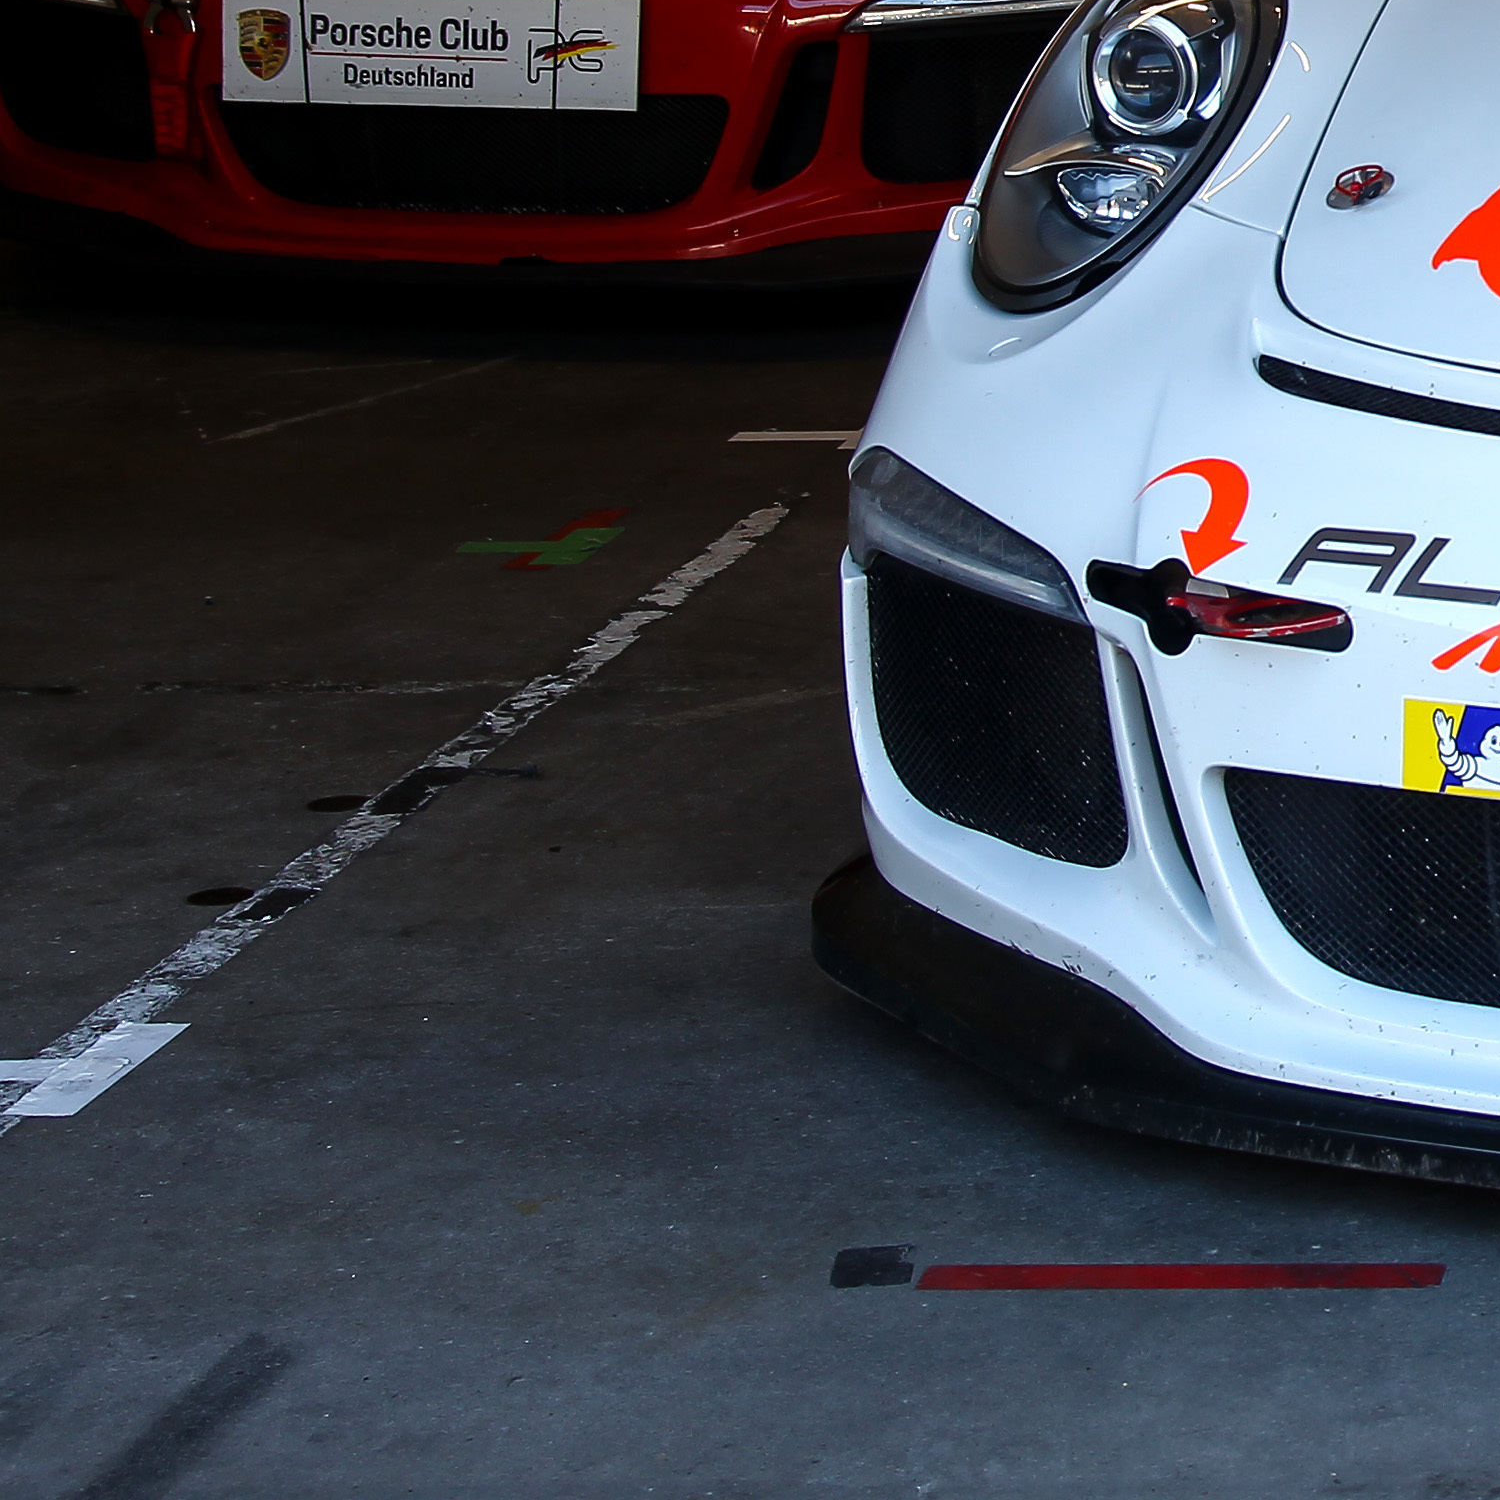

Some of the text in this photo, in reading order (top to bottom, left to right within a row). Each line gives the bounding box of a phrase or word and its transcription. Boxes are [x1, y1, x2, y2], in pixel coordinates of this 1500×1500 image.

[309, 13, 509, 52] Porsche Club
[342, 62, 475, 90] Deutschland
